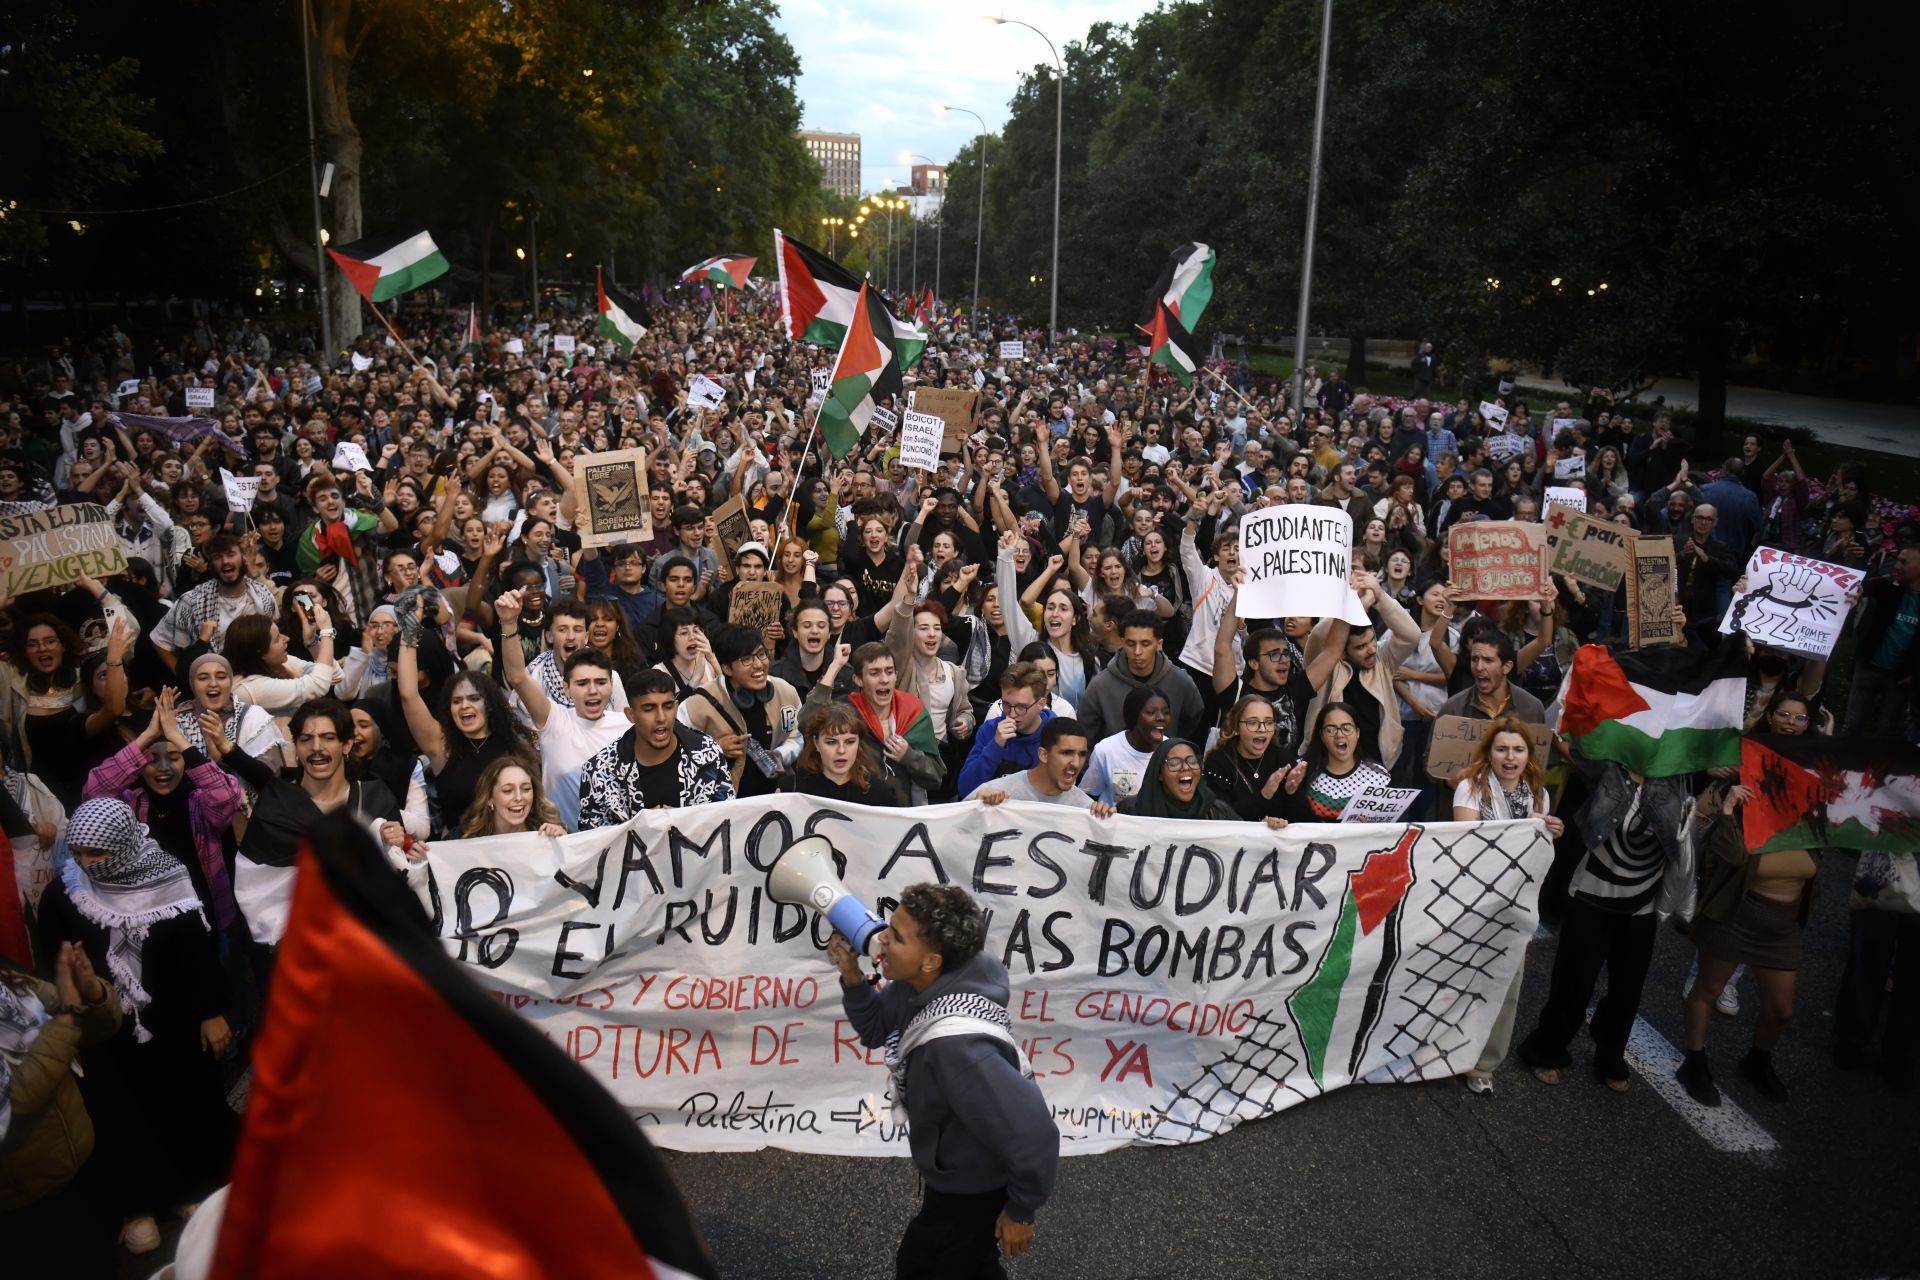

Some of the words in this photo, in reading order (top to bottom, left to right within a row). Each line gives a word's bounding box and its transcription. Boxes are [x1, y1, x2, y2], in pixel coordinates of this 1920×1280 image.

[813, 375, 828, 390] PAZ
[906, 413, 938, 426] BOICOT
[904, 423, 937, 437] ISRAEL:
[587, 463, 630, 474] PALESTINA
[588, 471, 610, 480] LIBRE
[45, 508, 73, 529] EL
[598, 514, 640, 525] SOBERANA
[612, 522, 624, 530] EN
[625, 520, 640, 528] PAZ
[1246, 515, 1348, 548] ESTUDIANTES
[12, 523, 117, 566] PALESTINA
[1264, 549, 1347, 581] PALESTINA
[735, 589, 782, 603] PALESTINA
[1362, 786, 1415, 800] BOICOT
[1353, 799, 1403, 813] ISRAEL:
[877, 822, 949, 884] A
[972, 828, 1338, 916] ESTUDIAR
[1098, 917, 1317, 982] BOMBAS
[633, 974, 657, 1006] Y
[663, 975, 818, 1011] GOBIERNO
[1020, 990, 1055, 1022] EL
[1075, 990, 1255, 1036] GENOCIDIO
[751, 1021, 804, 1066] DE
[1100, 1037, 1153, 1088] YA
[678, 1090, 823, 1135] Palestina
